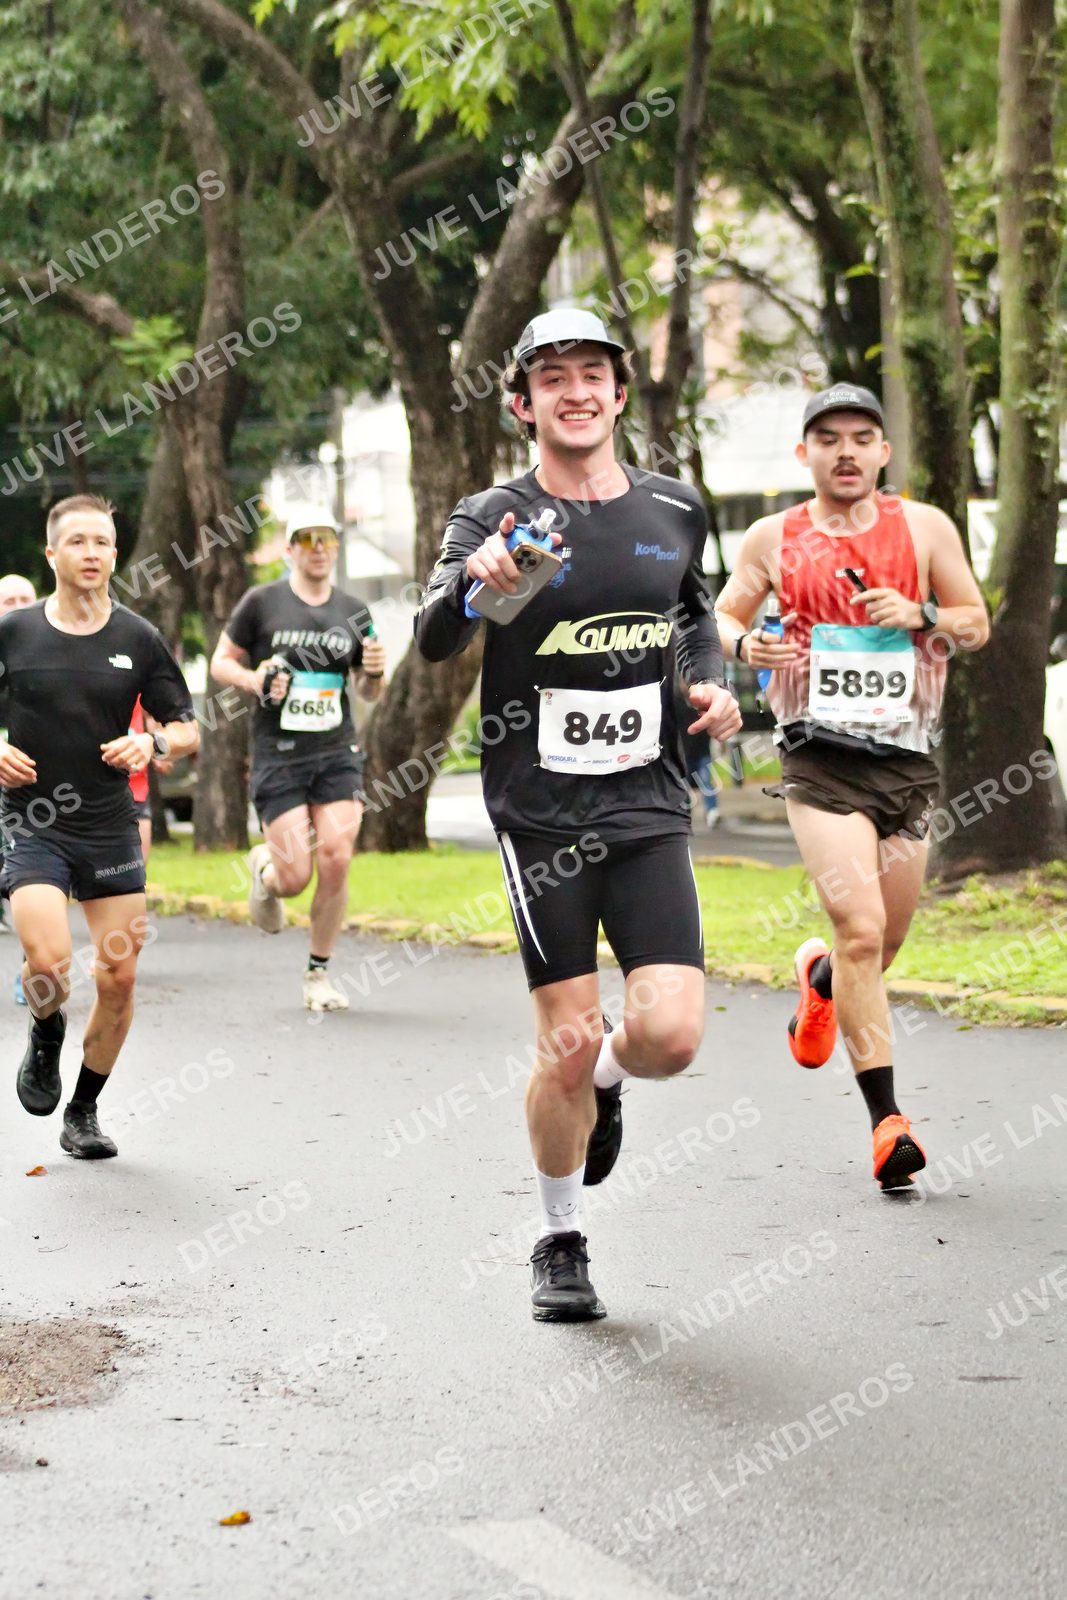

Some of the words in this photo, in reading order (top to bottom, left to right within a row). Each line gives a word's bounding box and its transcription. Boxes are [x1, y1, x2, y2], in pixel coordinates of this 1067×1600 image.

[535, 615, 674, 656] KOUMORI
[818, 669, 907, 698] 5899
[288, 699, 336, 716] 6684
[563, 709, 642, 746] 849
